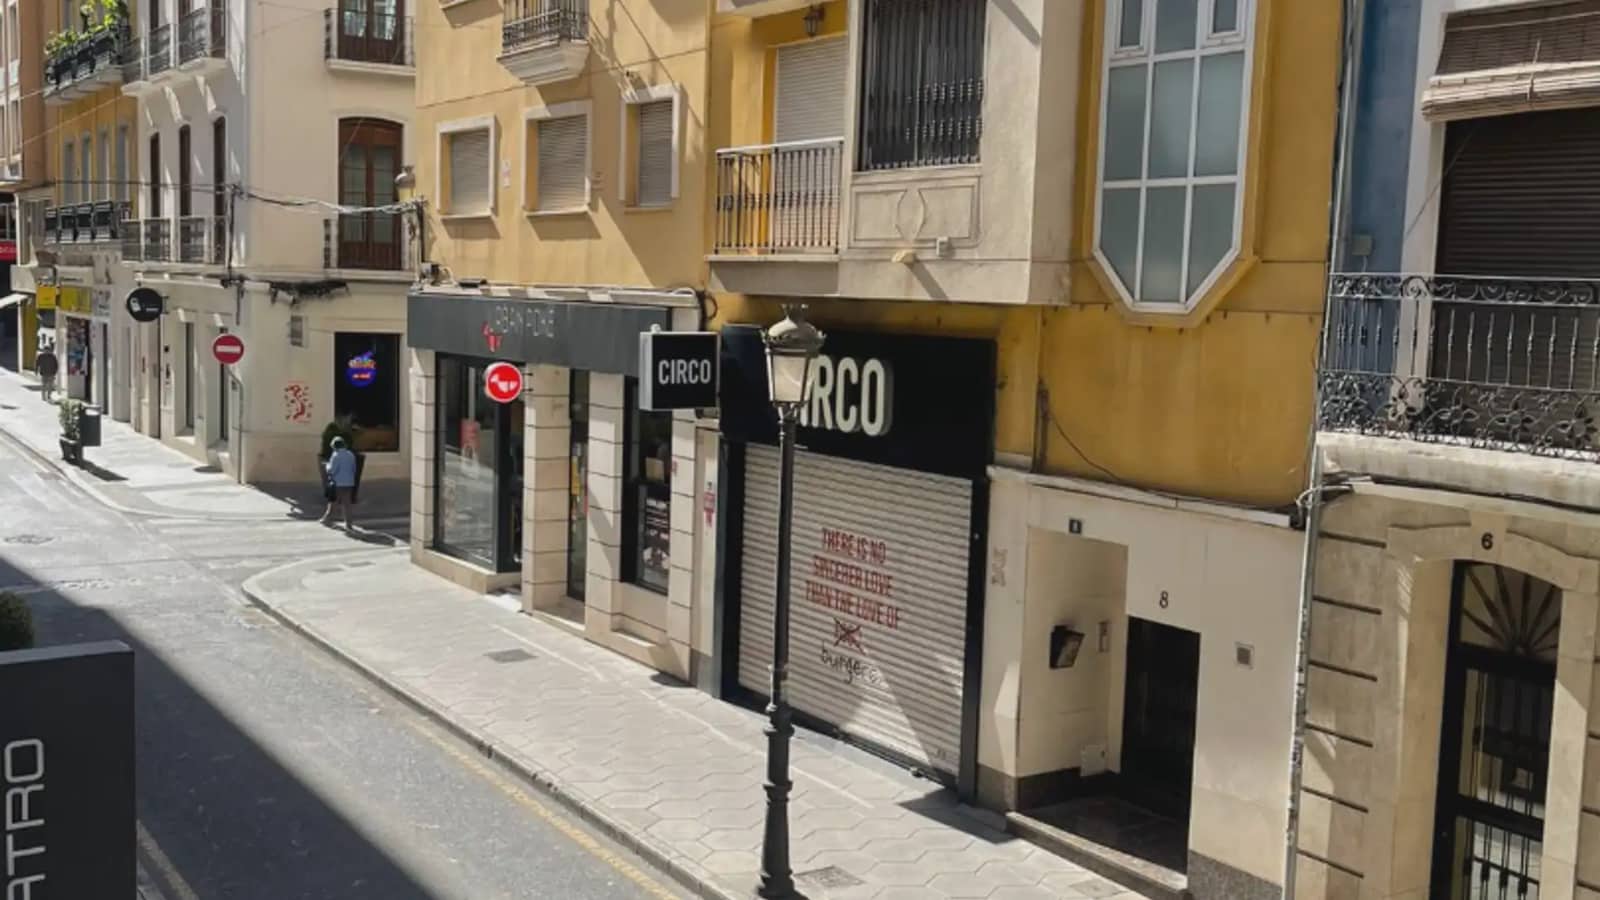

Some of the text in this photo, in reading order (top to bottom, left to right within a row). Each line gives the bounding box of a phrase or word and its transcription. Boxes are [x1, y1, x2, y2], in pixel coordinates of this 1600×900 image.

[658, 359, 712, 385] CIRCO
[796, 354, 886, 436] IRCO
[822, 528, 887, 565] THERE IS NO
[1481, 532, 1493, 551] 6
[864, 569, 893, 597] LOVE
[805, 580, 832, 609] THAN
[856, 595, 883, 624] LOVE
[886, 604, 901, 630] OF
[1159, 590, 1169, 608] 8
